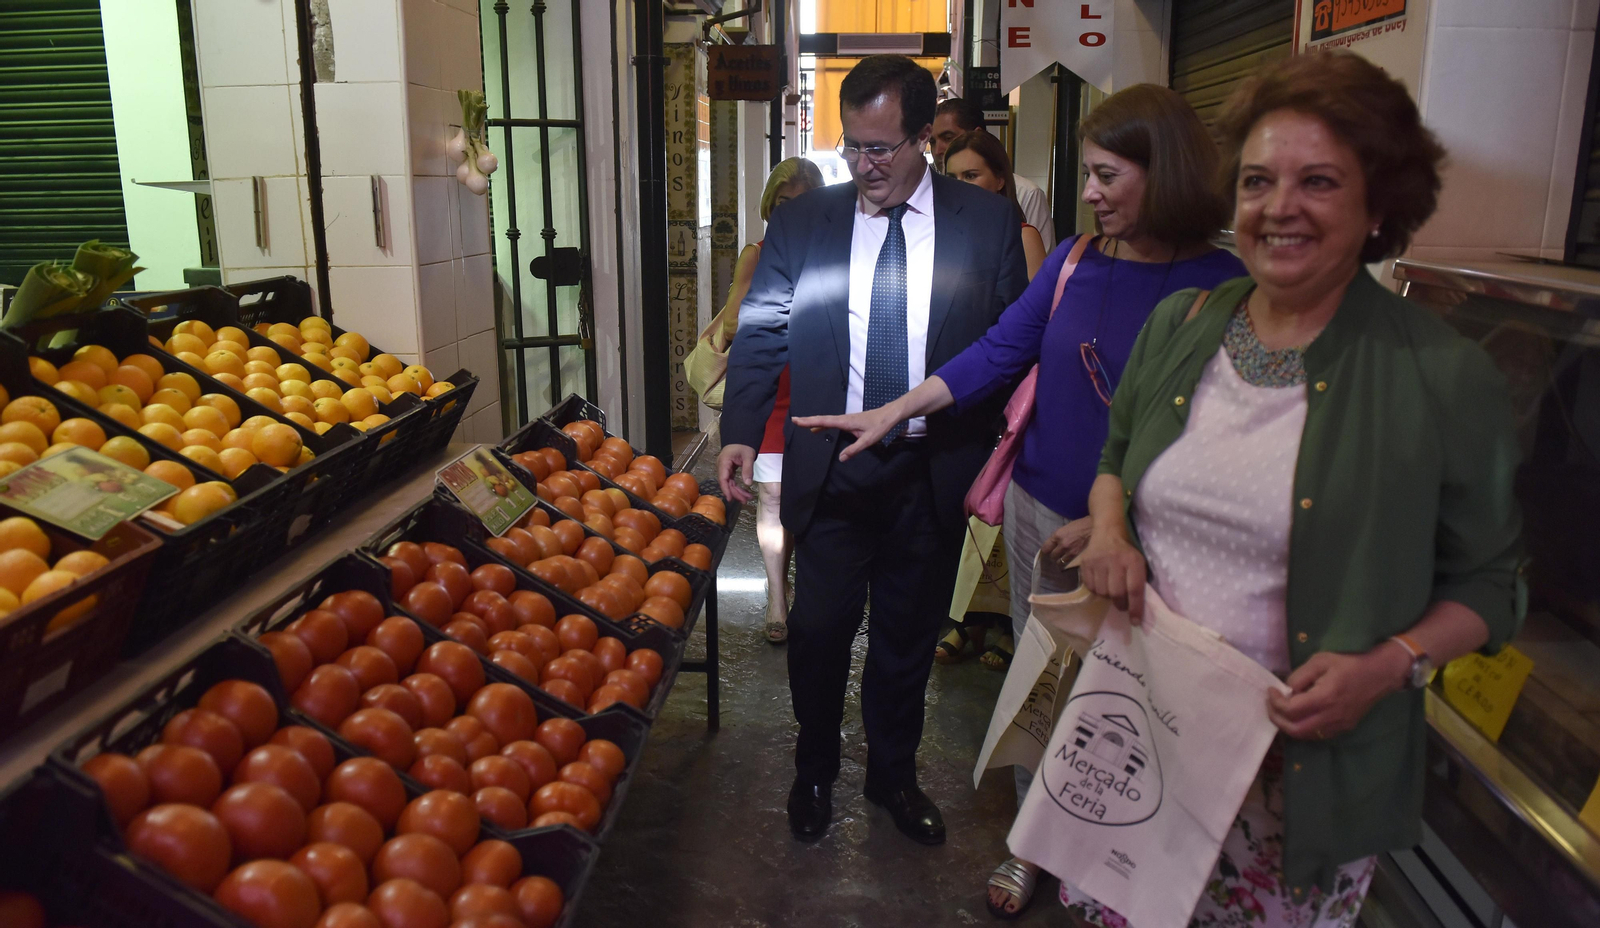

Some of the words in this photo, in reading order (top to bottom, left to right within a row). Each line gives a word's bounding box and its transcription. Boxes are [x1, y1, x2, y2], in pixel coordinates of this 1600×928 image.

[669, 83, 683, 191] Vinos
[673, 282, 687, 411] Licores
[1055, 744, 1141, 802] Mercado
[1059, 781, 1107, 820] Feria
[1080, 778, 1093, 790] de
[1095, 782, 1104, 796] la
